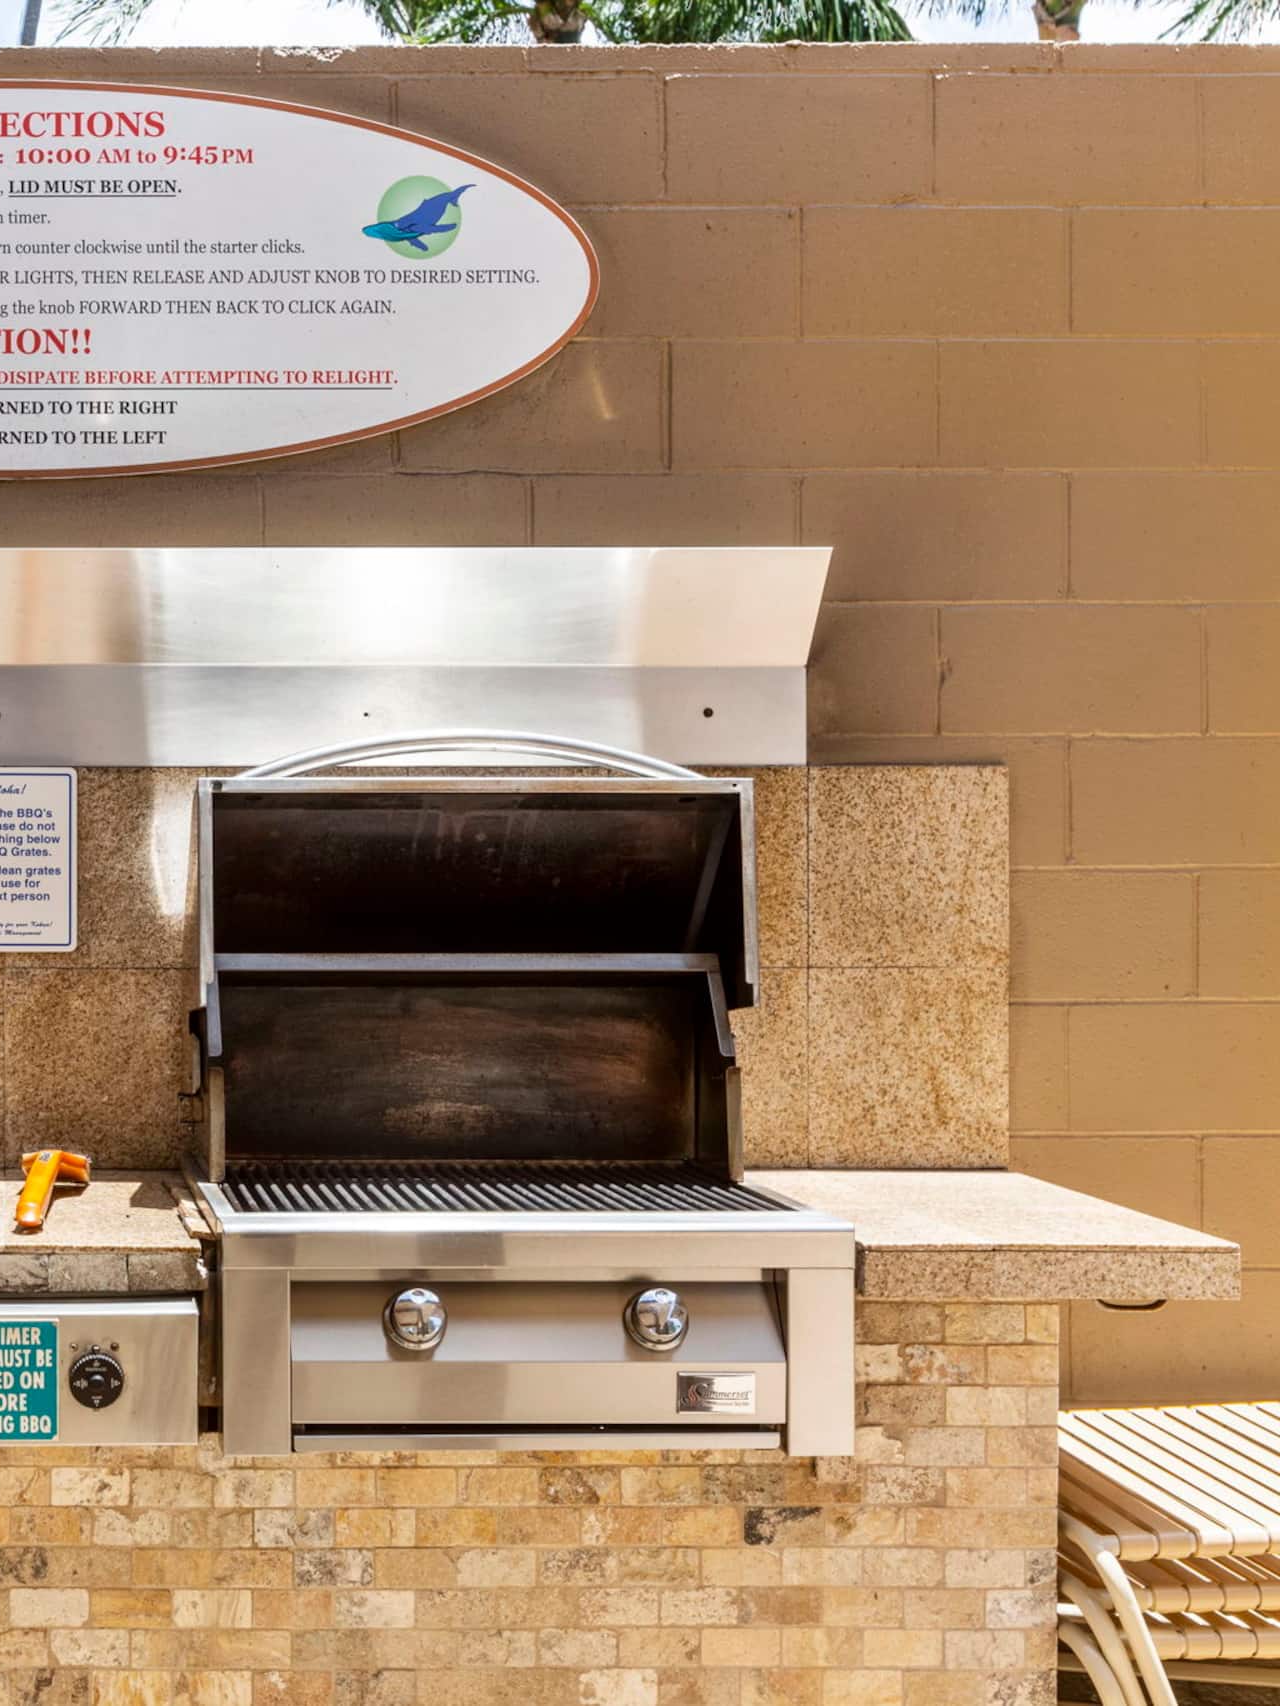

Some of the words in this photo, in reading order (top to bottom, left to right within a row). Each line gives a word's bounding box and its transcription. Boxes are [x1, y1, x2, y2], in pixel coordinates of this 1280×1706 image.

[15, 148, 91, 165] 10:00
[96, 149, 132, 164] AM
[136, 148, 158, 165] to
[8, 179, 40, 194] LID
[44, 179, 96, 194] MUST
[100, 179, 124, 194] BE
[127, 179, 182, 194] OPEN.
[7, 209, 51, 225] timer.
[14, 241, 71, 255] counter
[73, 239, 143, 255] clockwise
[146, 239, 180, 254] until
[183, 239, 207, 254] the
[209, 241, 259, 254] starter
[260, 238, 305, 254] clicks.
[14, 270, 78, 287] LIGHTS,
[80, 270, 128, 285] THEN
[132, 269, 205, 285] RELEASE
[207, 269, 244, 284] AND
[247, 269, 311, 284] ADJUST
[314, 269, 361, 284] KNOB
[363, 269, 386, 284] TO
[390, 269, 462, 284] DESIRED
[465, 269, 540, 284] SETTING.
[12, 299, 36, 315] the
[38, 299, 75, 315] knob
[79, 300, 162, 315] FORWARD
[164, 300, 212, 315] THEN
[216, 299, 260, 315] BACK
[261, 299, 285, 314] TO
[288, 299, 337, 315] CLICK
[339, 299, 396, 315] AGAIN.
[84, 370, 157, 385] BEFORE
[160, 370, 279, 385] ATTEMPTING
[282, 370, 308, 385] TO
[312, 370, 398, 385] RELIGHT.
[47, 400, 74, 415] TO
[76, 400, 115, 415] THE
[119, 400, 178, 415] RIGHT
[50, 430, 77, 445] TO
[79, 430, 118, 445] THE
[123, 430, 167, 445] LEFT
[18, 820, 34, 832] do
[36, 821, 56, 832] not
[26, 834, 61, 845] below
[10, 846, 53, 858] Grates.
[25, 866, 62, 878] grates
[0, 880, 22, 889] use
[24, 878, 41, 889] for
[10, 892, 51, 904] person
[35, 1348, 53, 1367] BE
[19, 1371, 45, 1390] ON
[19, 1415, 52, 1434] BBQ
